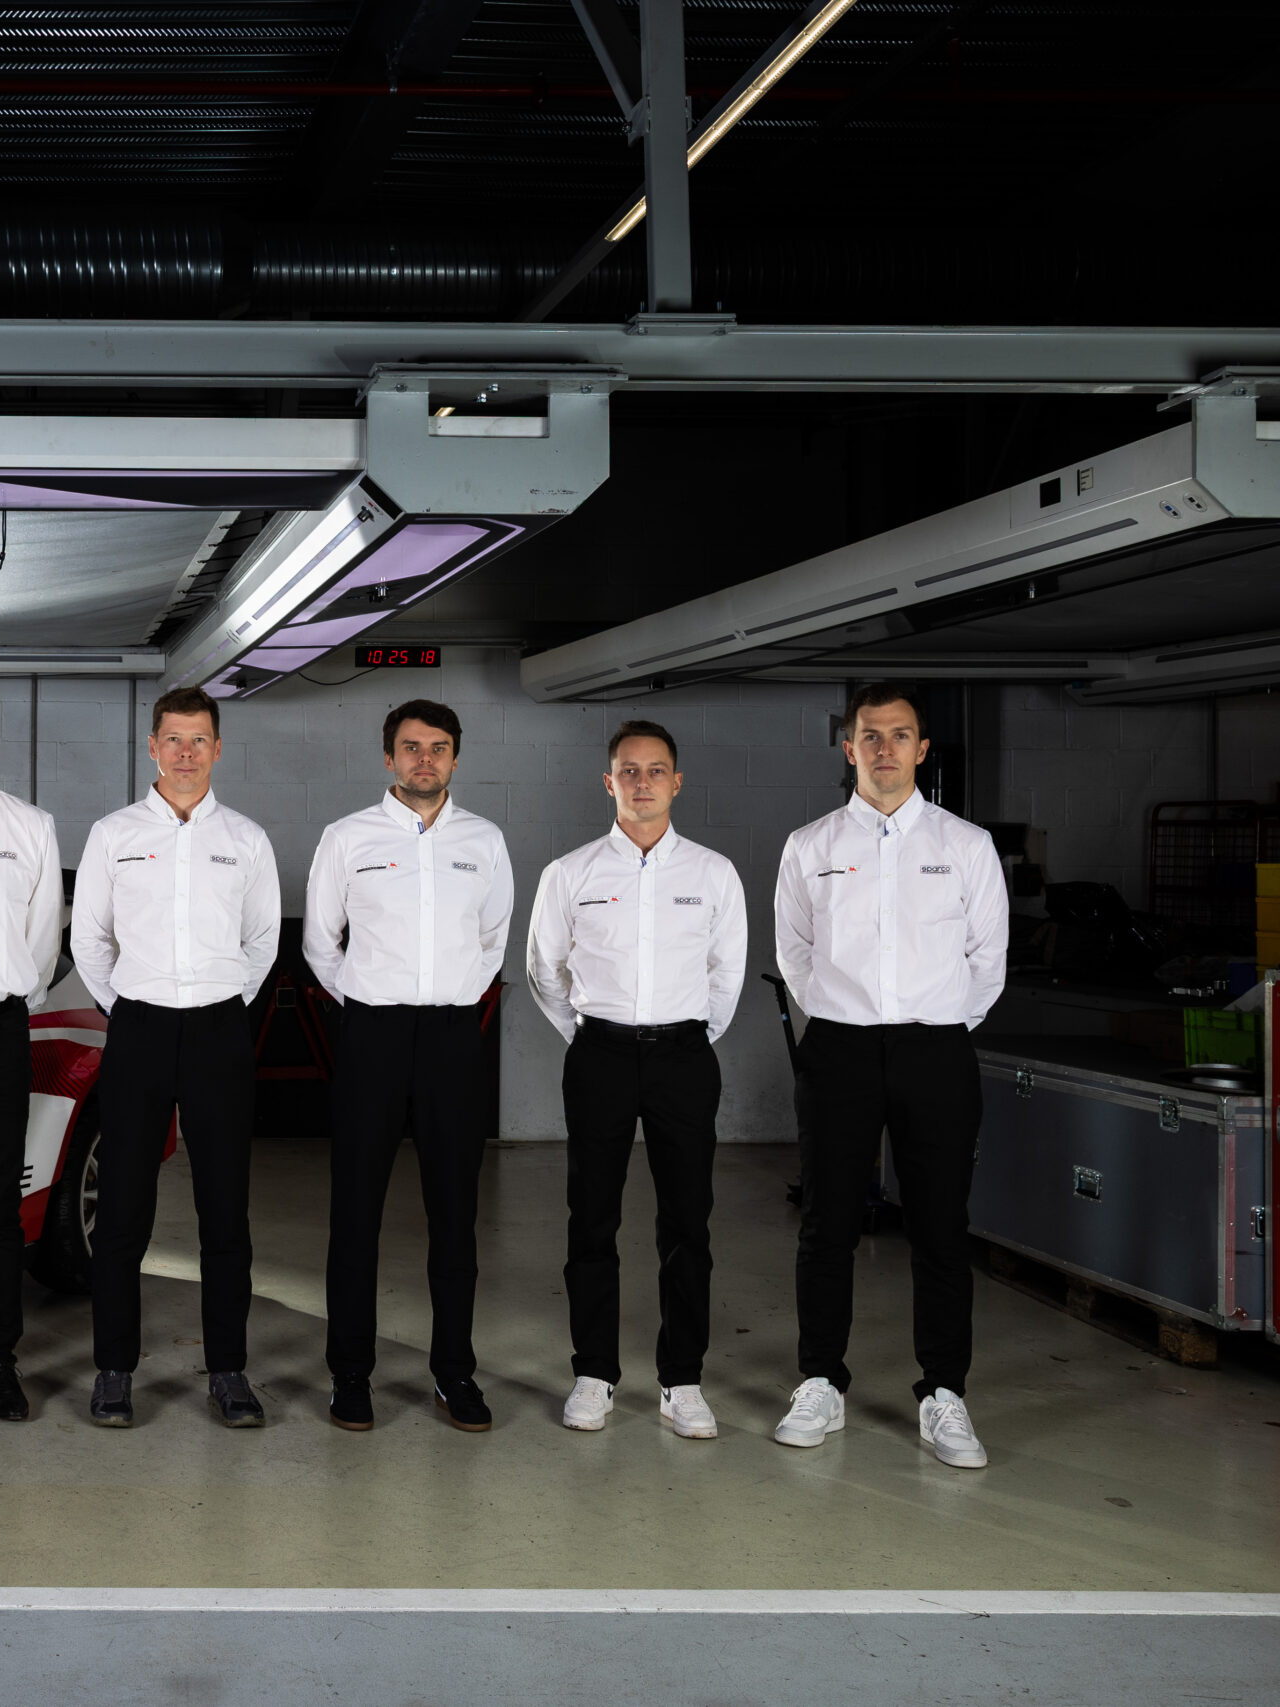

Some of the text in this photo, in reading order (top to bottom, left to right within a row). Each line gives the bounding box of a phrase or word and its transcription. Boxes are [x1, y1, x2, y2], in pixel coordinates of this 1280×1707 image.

[368, 650, 436, 664] 10 25 18
[921, 866, 951, 874] sparco
